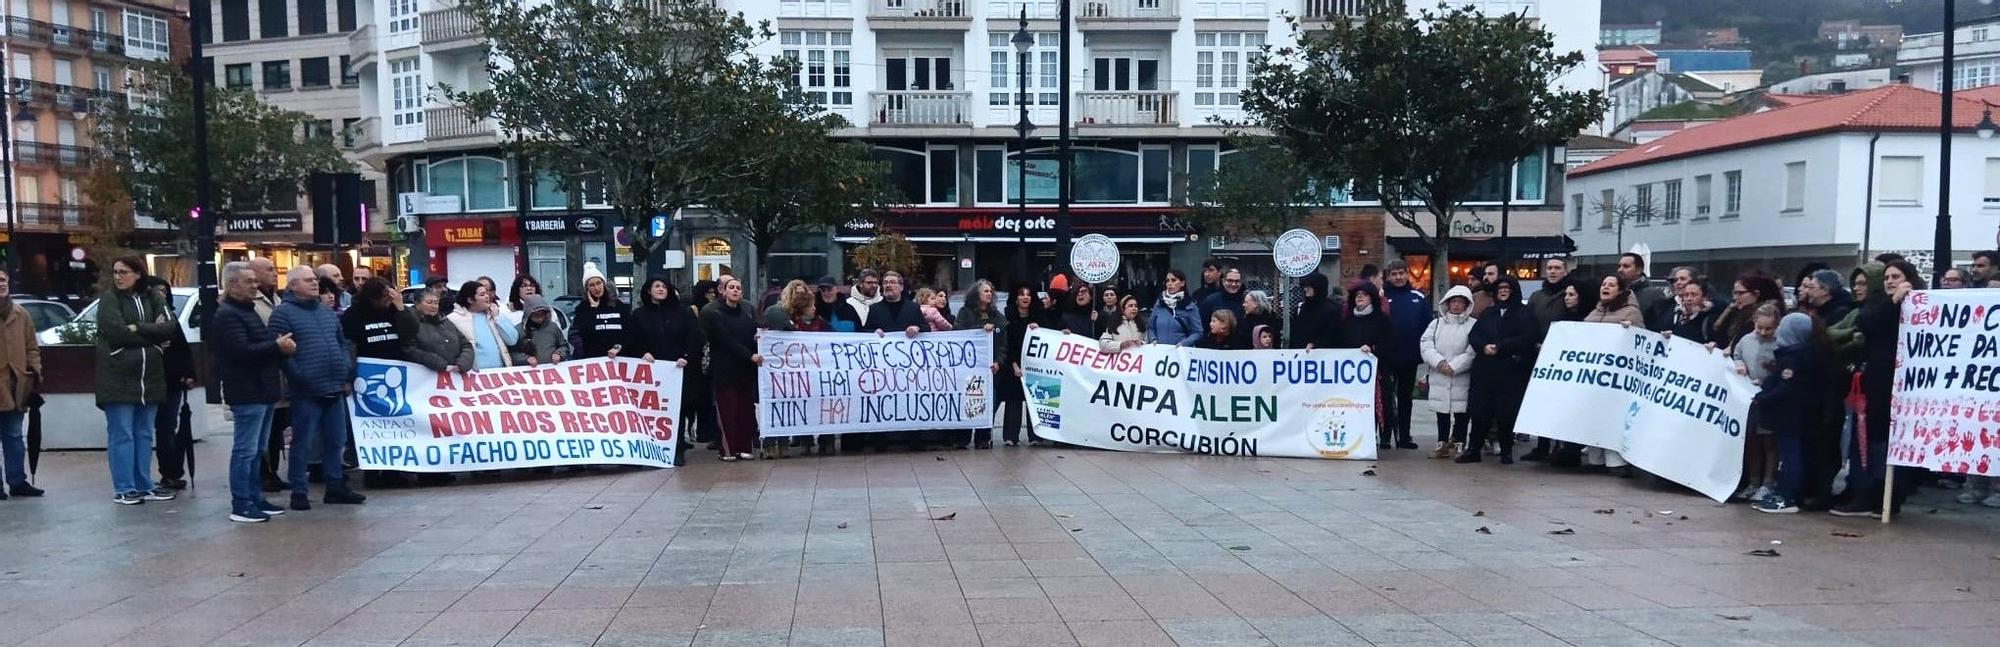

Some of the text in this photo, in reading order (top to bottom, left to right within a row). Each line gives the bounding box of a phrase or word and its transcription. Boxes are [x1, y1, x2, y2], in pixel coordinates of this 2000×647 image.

[1940, 303, 1971, 328] NO
[769, 339, 977, 371] SEN PROFESORADO
[1906, 329, 1998, 359] VIRXE DA
[1026, 335, 1373, 385] En DEFENSA do ENSINO PÚBLICO
[436, 371, 457, 391] A
[568, 361, 661, 387] FALLA,
[770, 371, 812, 399] NIN
[819, 370, 852, 398] HAI
[1559, 349, 1634, 371] recursos
[1663, 370, 1702, 393] para
[1704, 383, 1728, 404] un
[1904, 366, 1938, 391] NON
[429, 385, 669, 411] O FACHO BERRA:
[770, 400, 808, 428] NIN
[819, 397, 851, 425] HAI
[1089, 380, 1278, 423] ANPA ALEN
[360, 418, 401, 430] ANPA
[362, 430, 417, 440] FACHO
[428, 411, 495, 438] NON
[500, 411, 557, 434] AOS
[359, 446, 420, 467] ANPA
[426, 446, 442, 466] O
[449, 441, 518, 465] FACHO
[522, 439, 551, 461] DO
[556, 439, 596, 459] CEIP
[601, 438, 625, 458] OS
[1110, 422, 1258, 457] CORCUBIÓN
